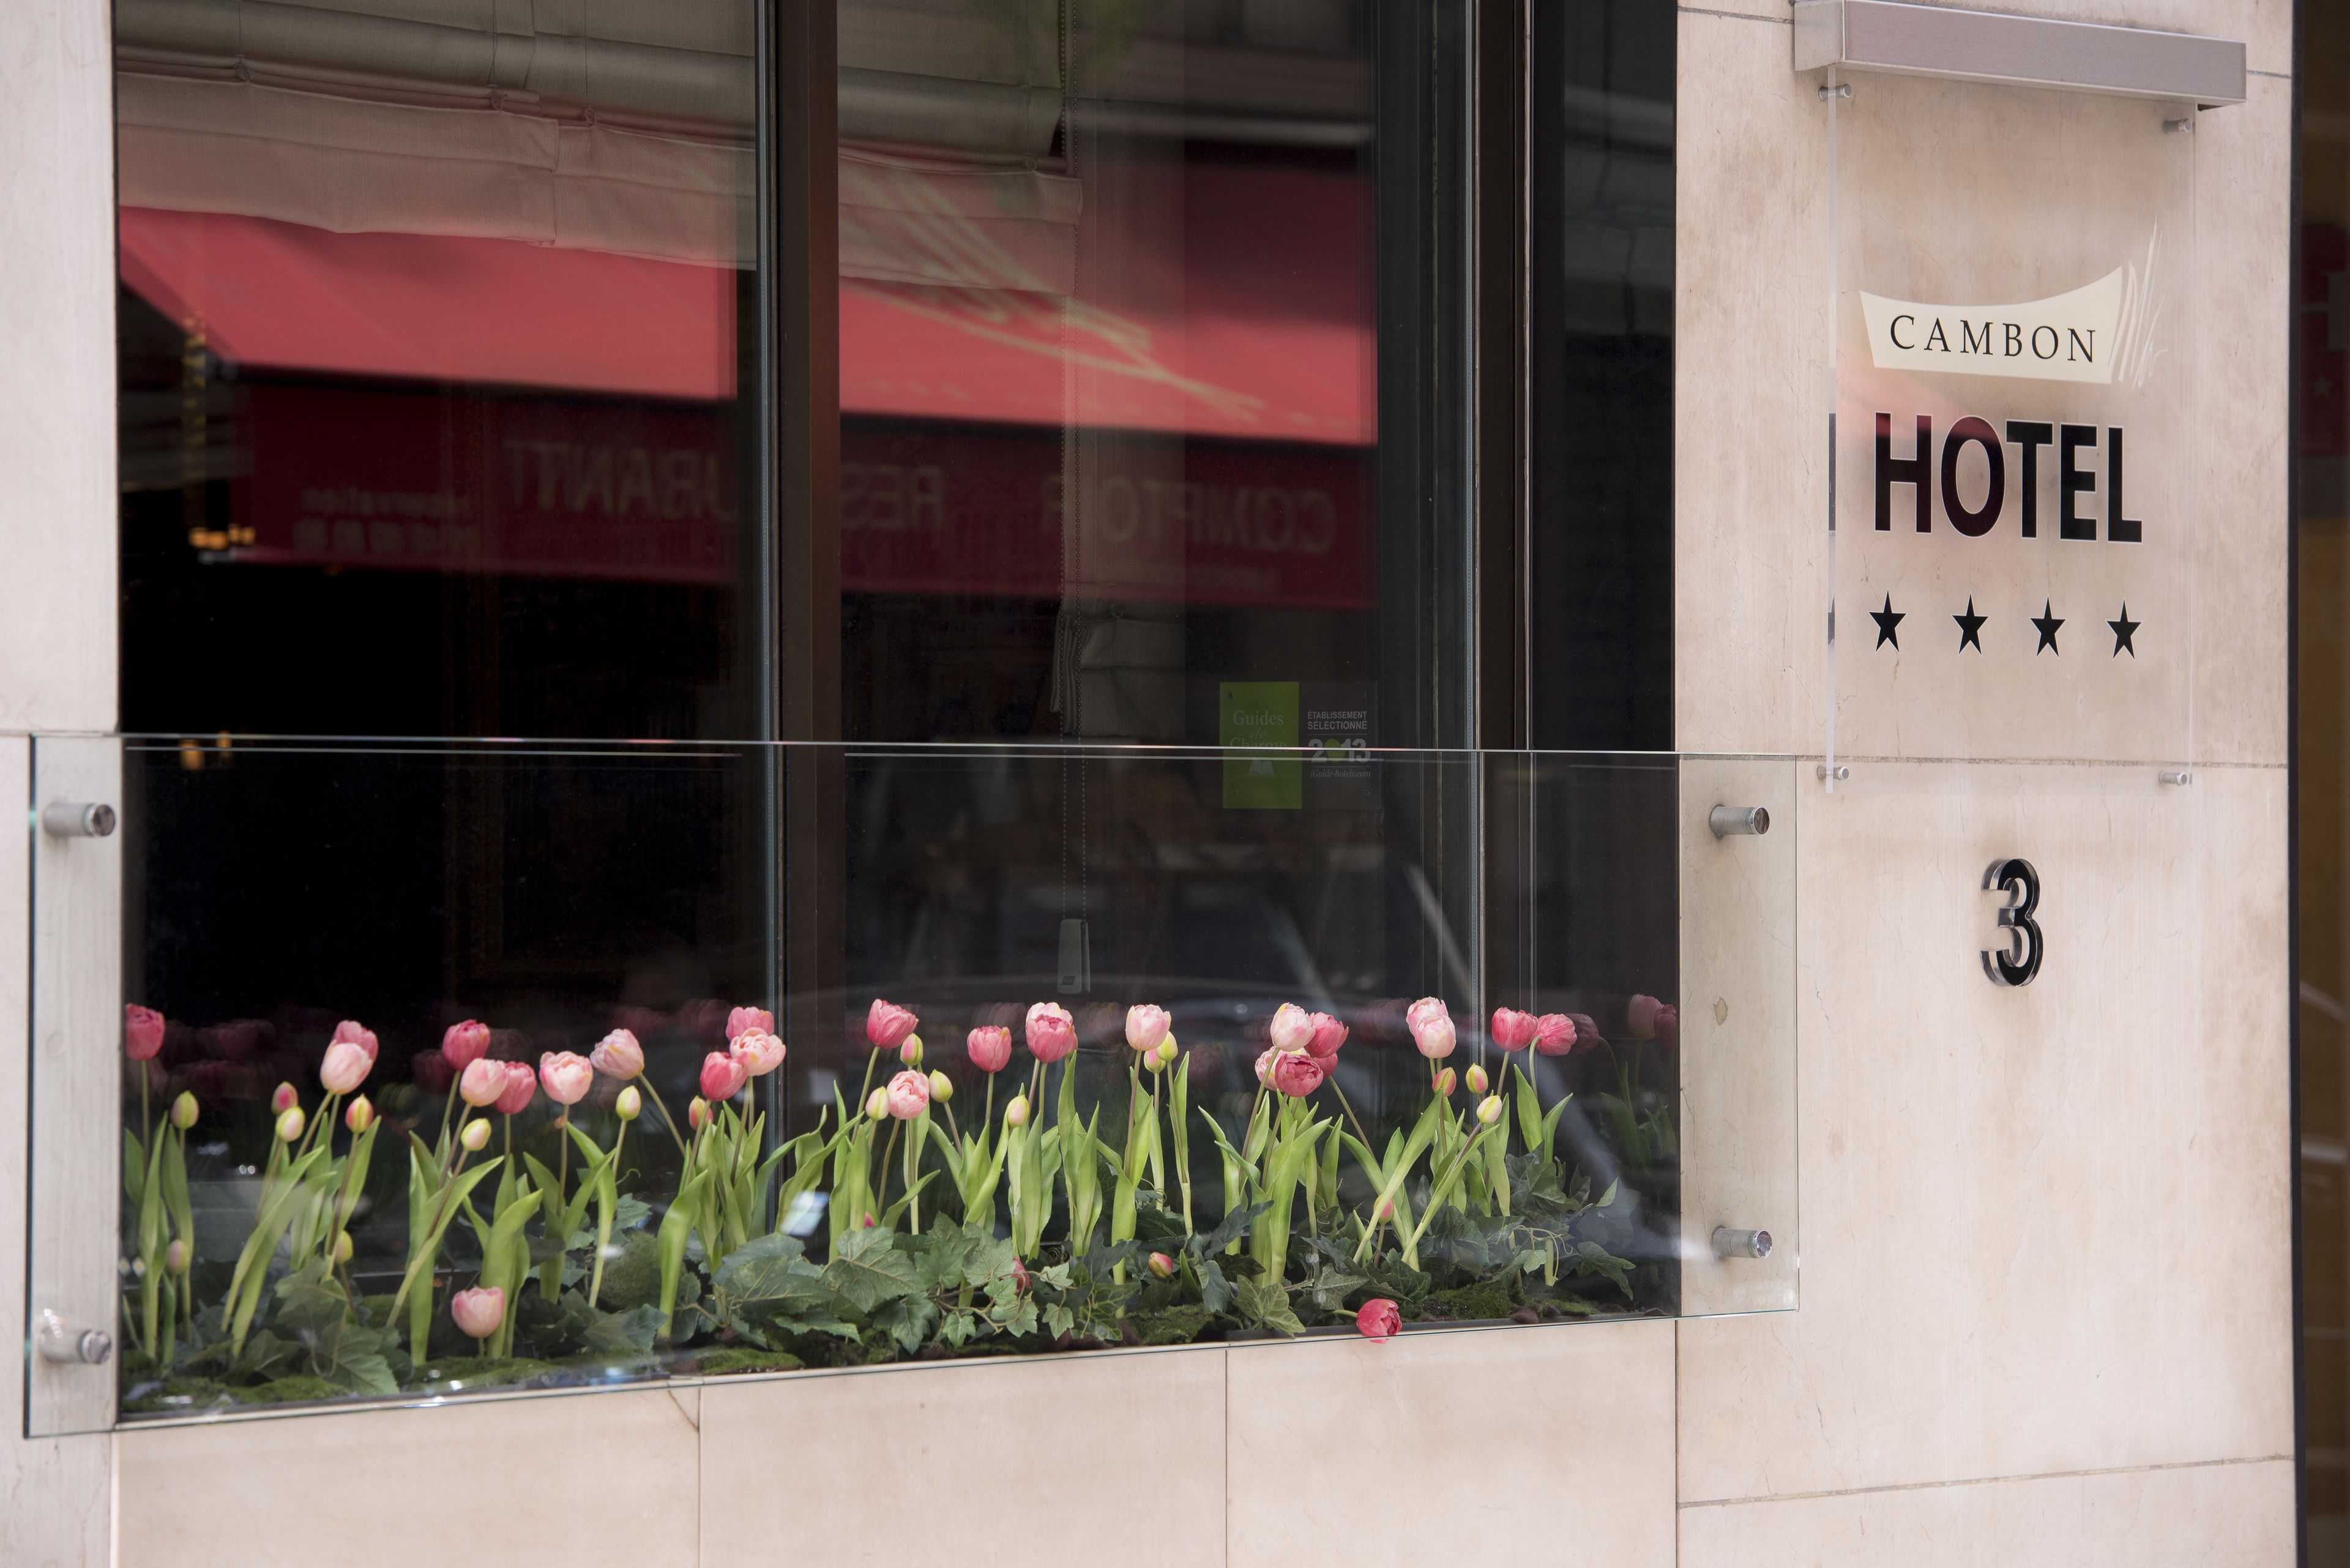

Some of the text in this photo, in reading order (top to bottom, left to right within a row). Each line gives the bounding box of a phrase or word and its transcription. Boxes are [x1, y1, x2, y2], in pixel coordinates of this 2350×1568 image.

[1890, 315, 2096, 364] CAMBON
[1874, 411, 2143, 544] HOTEL
[1233, 709, 1284, 726] Guides
[1307, 710, 1368, 719] ÉTABLISSEMENT
[1249, 727, 1268, 739] de
[1307, 719, 1368, 730] SÉLECTIONNÉ
[1308, 738, 1371, 763] 2013
[1310, 769, 1371, 778] iGuide-hotels.com
[1980, 858, 2043, 987] 3
